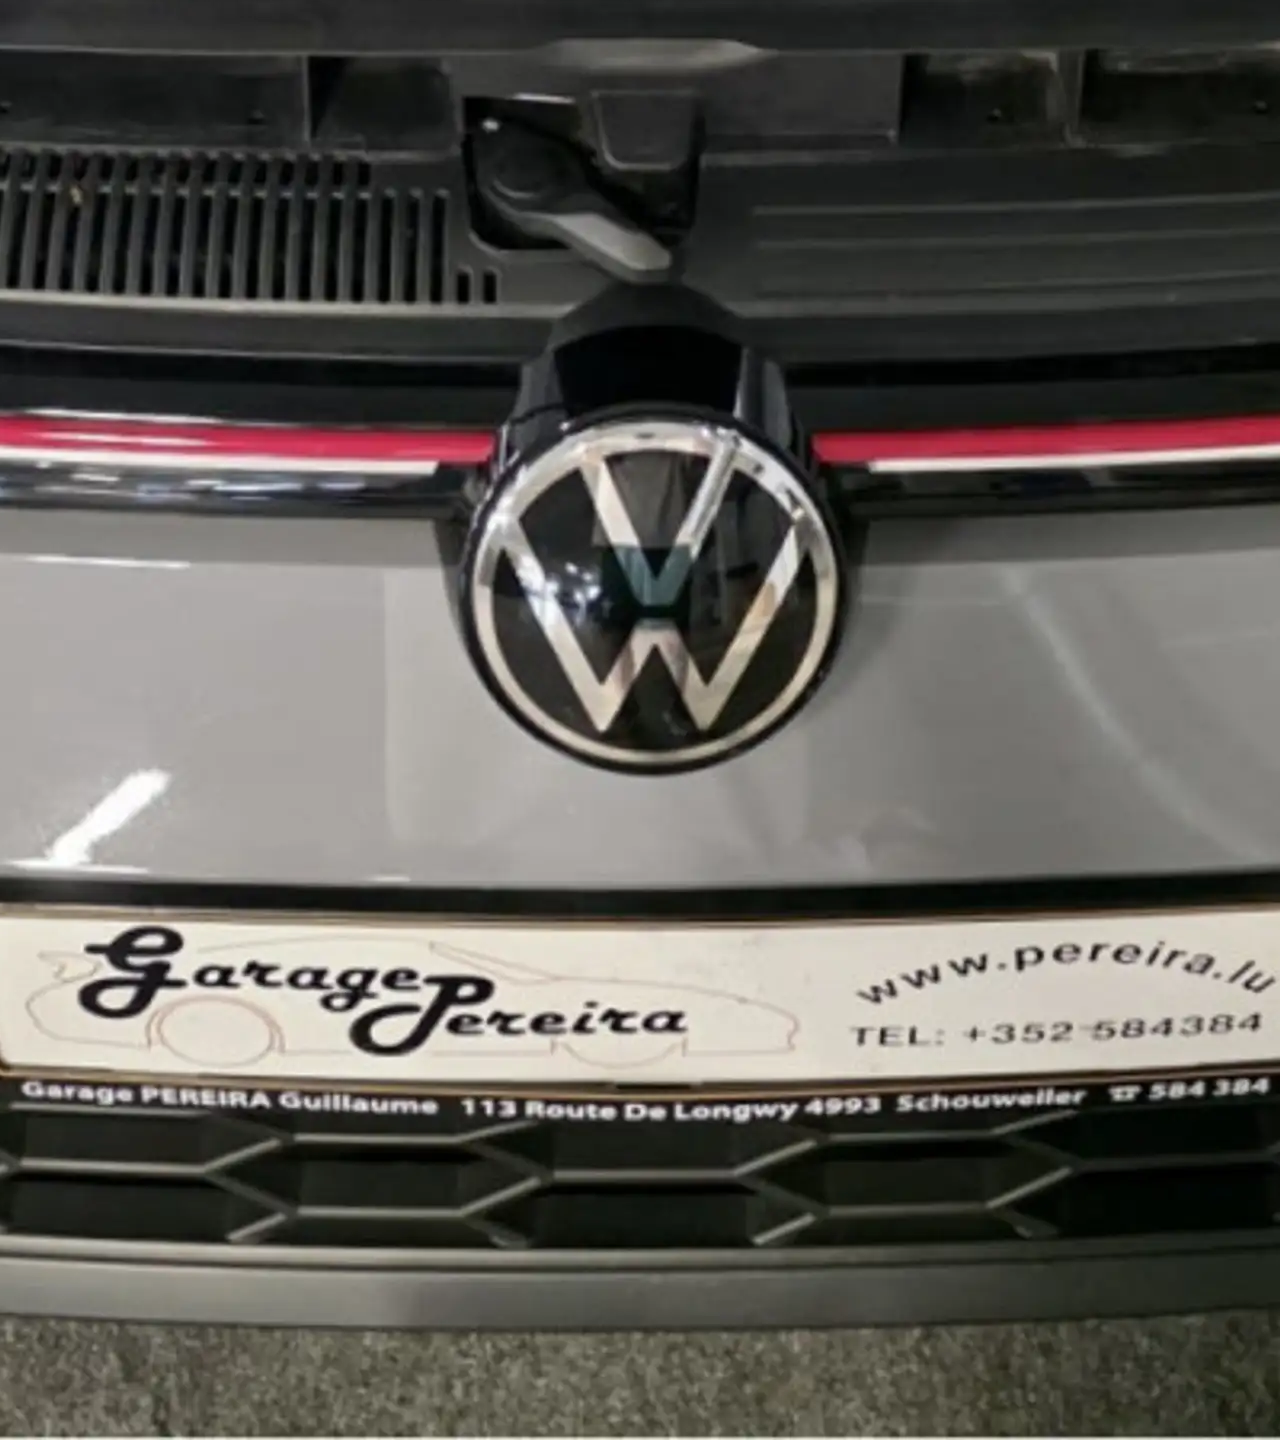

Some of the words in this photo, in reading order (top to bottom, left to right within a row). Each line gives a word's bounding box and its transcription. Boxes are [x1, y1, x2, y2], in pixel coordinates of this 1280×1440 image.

[78, 925, 422, 1019] Garage
[856, 940, 1276, 1004] www.pereira.lu
[349, 974, 687, 1057] Pereira
[850, 1024, 944, 1047] TEL:
[21, 1080, 133, 1105] Garage
[140, 1084, 271, 1109] PEREIRA
[277, 1090, 439, 1116] Guillaume
[460, 1098, 517, 1117] 113
[523, 1099, 618, 1120] Route
[624, 1102, 667, 1121] De
[675, 1101, 797, 1124] Longwy
[804, 1097, 881, 1116] 4993
[896, 1087, 1087, 1112] Schouweiler
[1148, 1081, 1205, 1101] 584
[1212, 1077, 1270, 1097] 384
